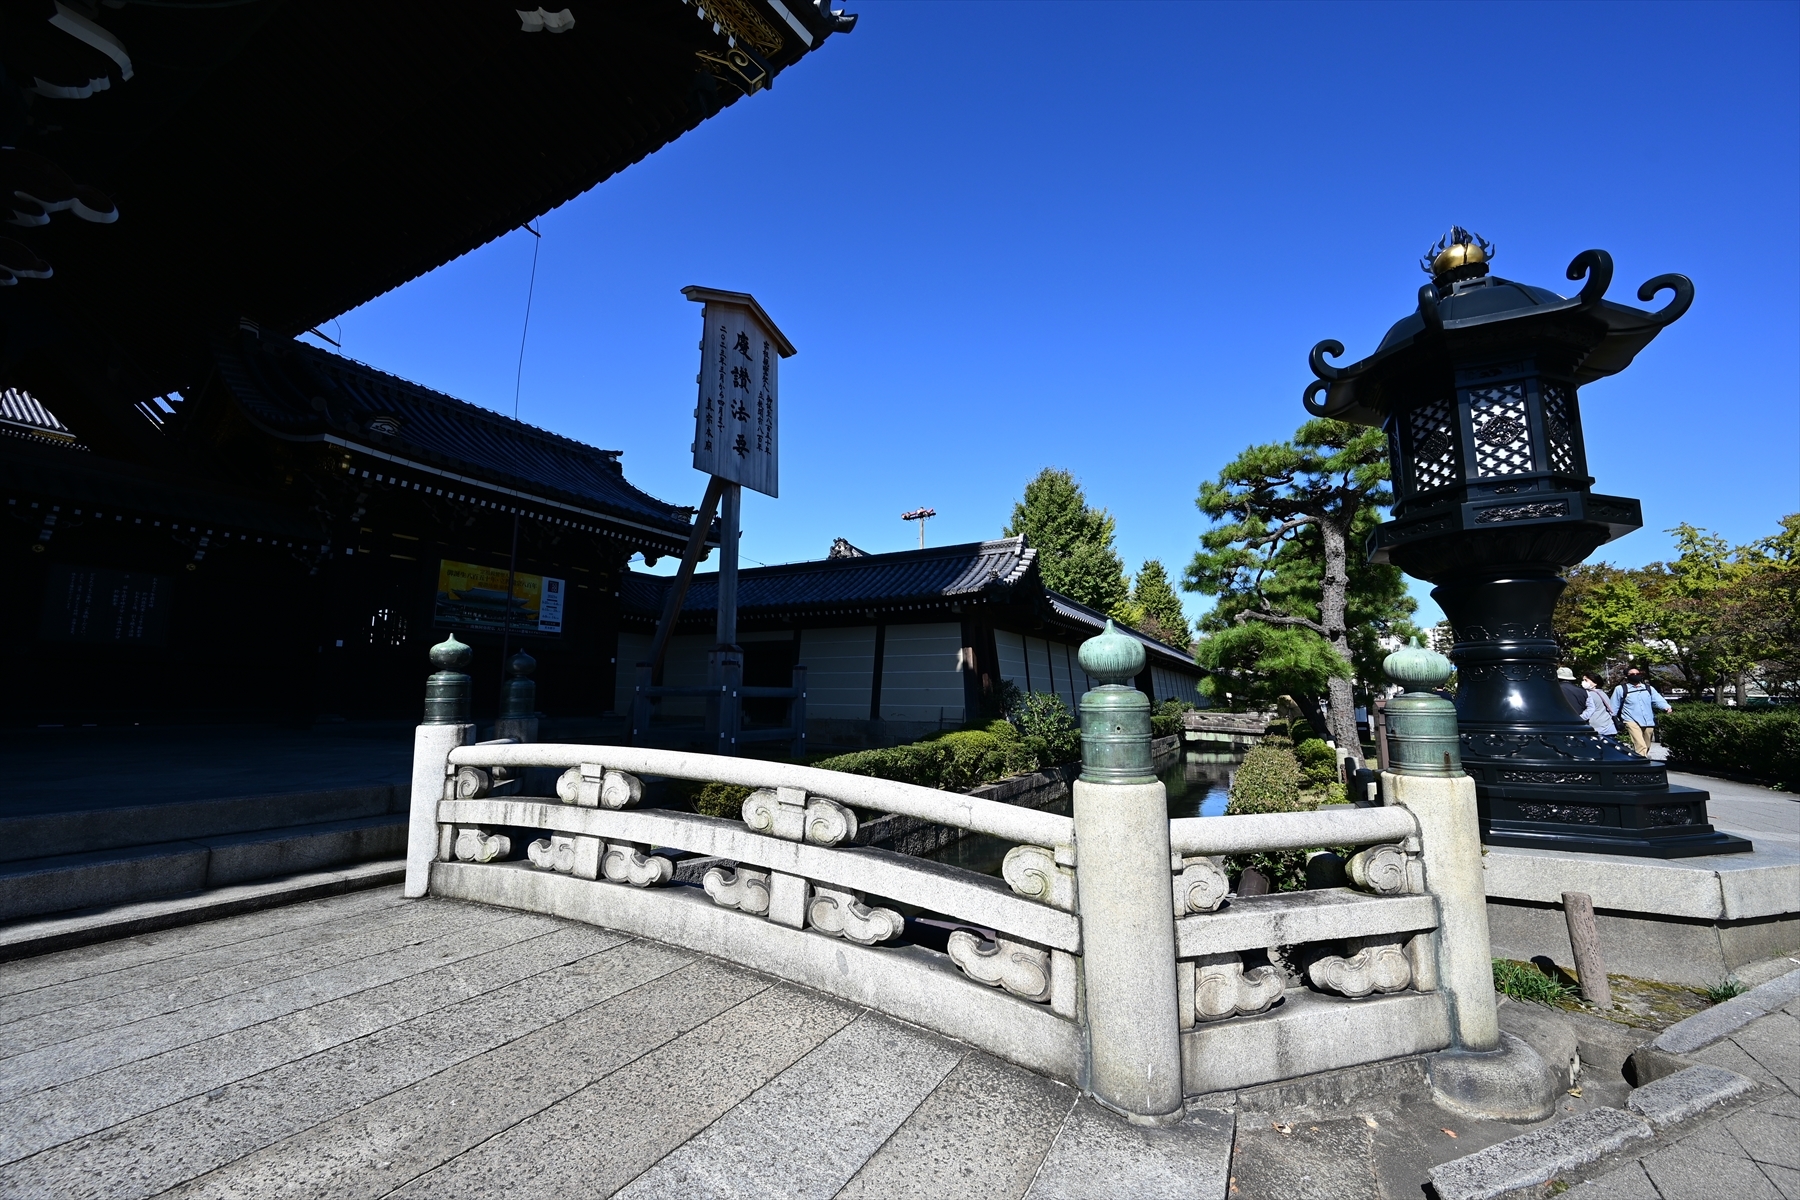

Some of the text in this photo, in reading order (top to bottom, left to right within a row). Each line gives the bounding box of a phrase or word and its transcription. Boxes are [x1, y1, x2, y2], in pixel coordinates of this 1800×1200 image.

[718, 326, 728, 433] 二〇二三年三月から四月まで
